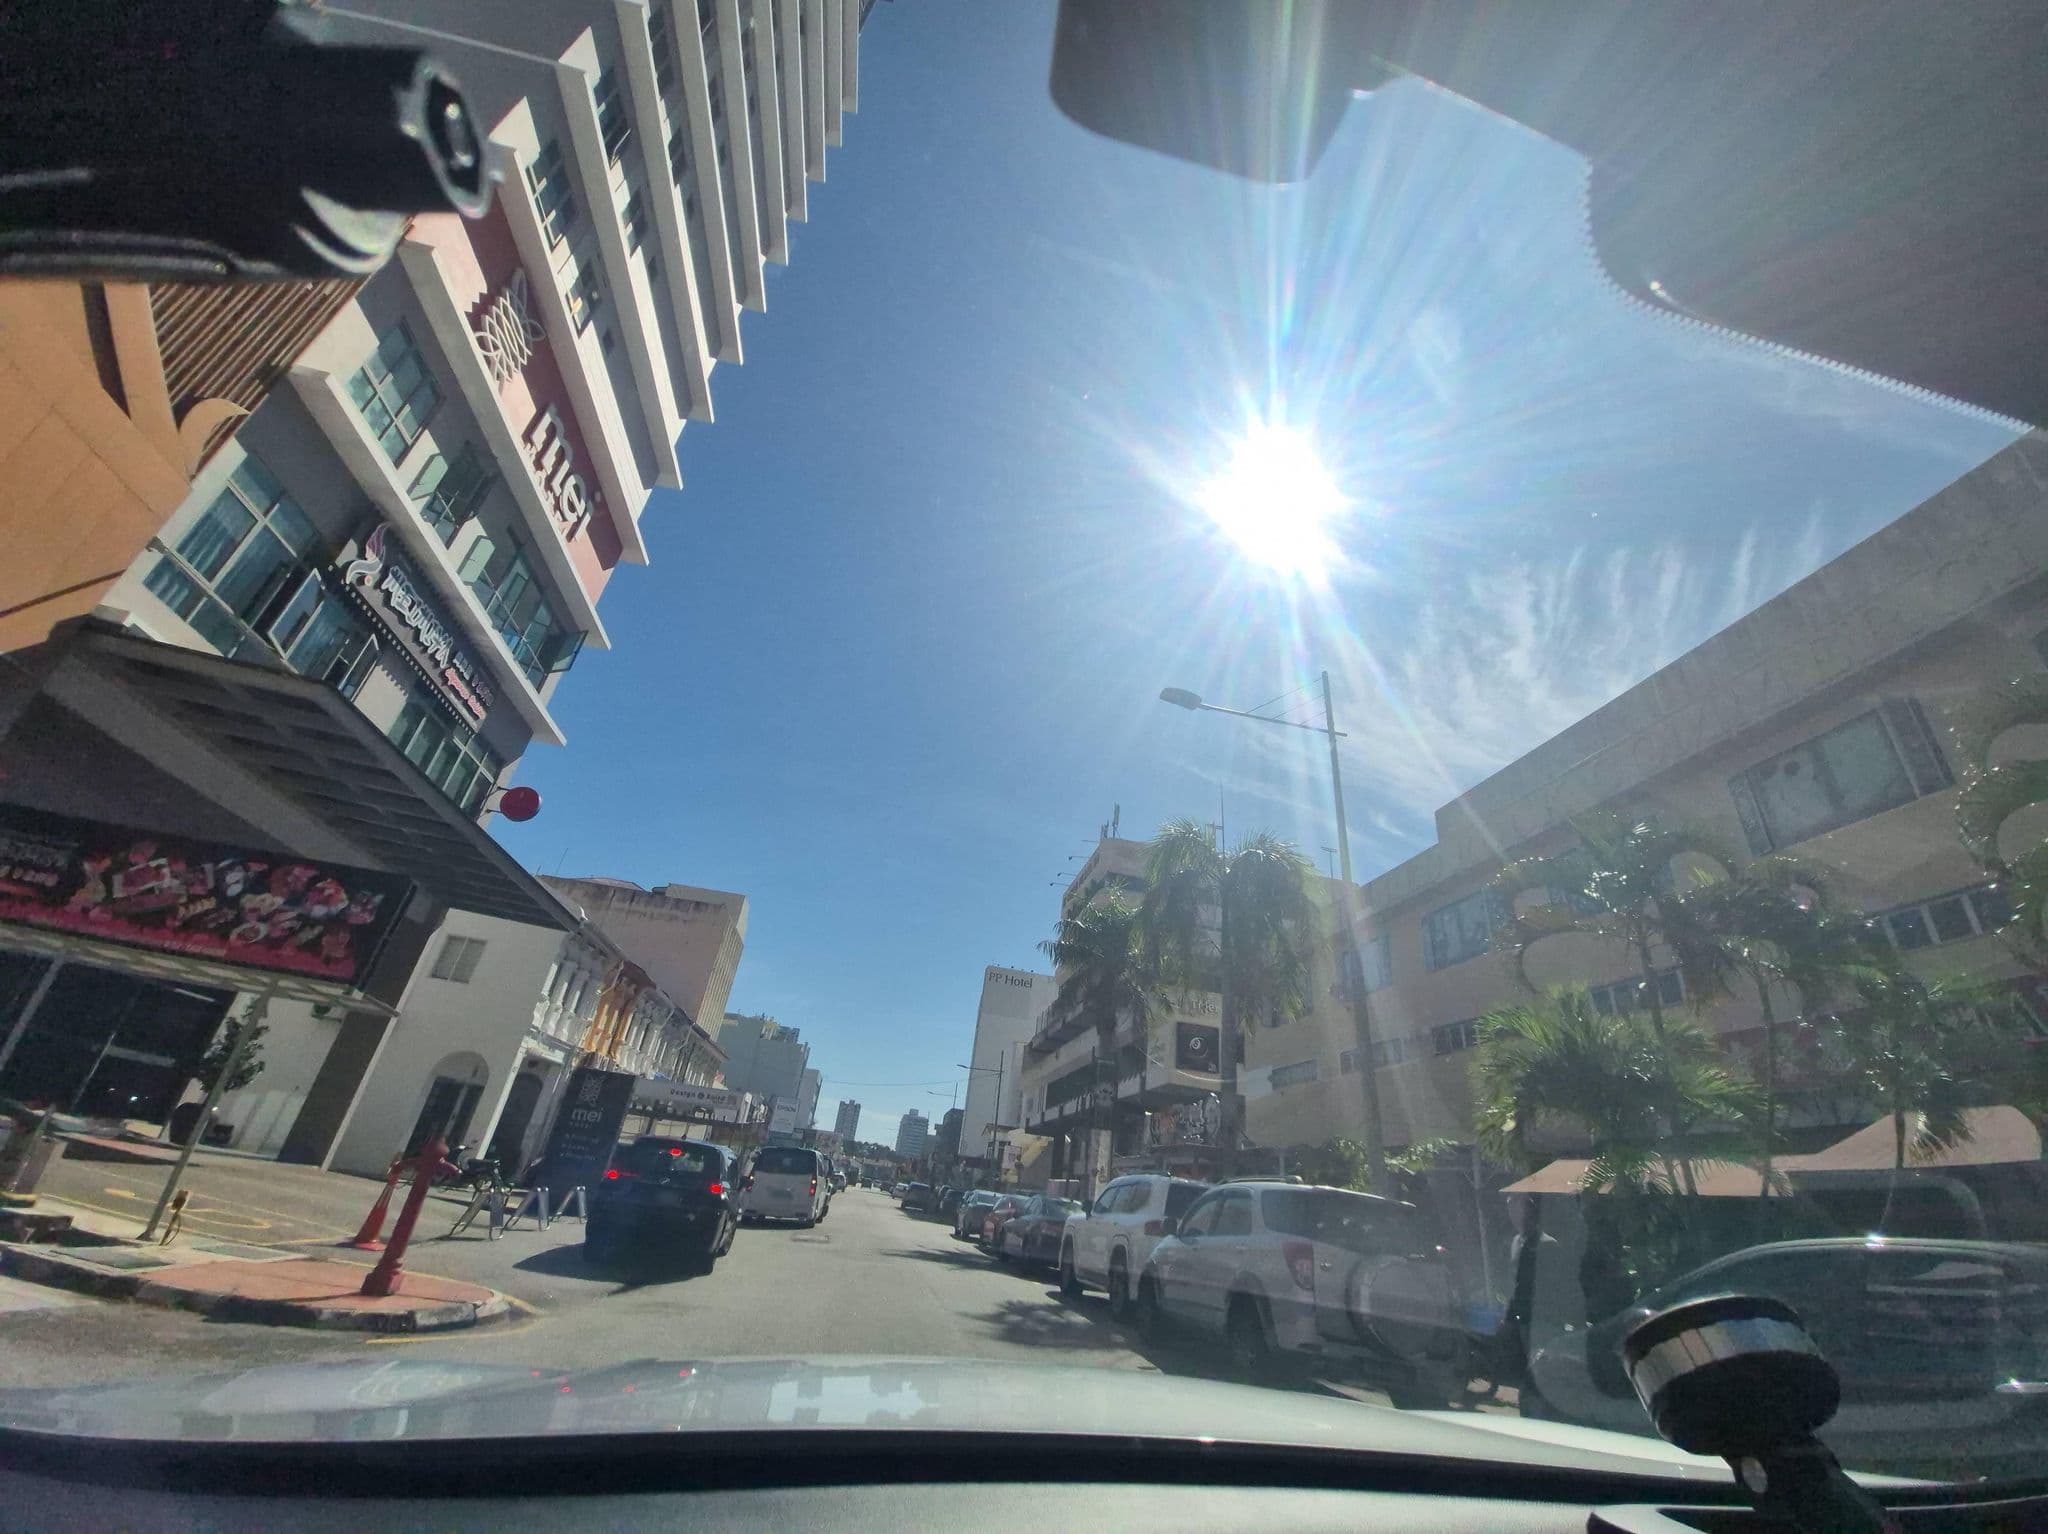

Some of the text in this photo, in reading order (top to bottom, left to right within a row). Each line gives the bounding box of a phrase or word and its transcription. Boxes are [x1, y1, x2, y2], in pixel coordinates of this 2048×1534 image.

[527, 403, 600, 536] mei
[989, 971, 1033, 988] PP Hotel
[572, 1107, 604, 1122] mei
